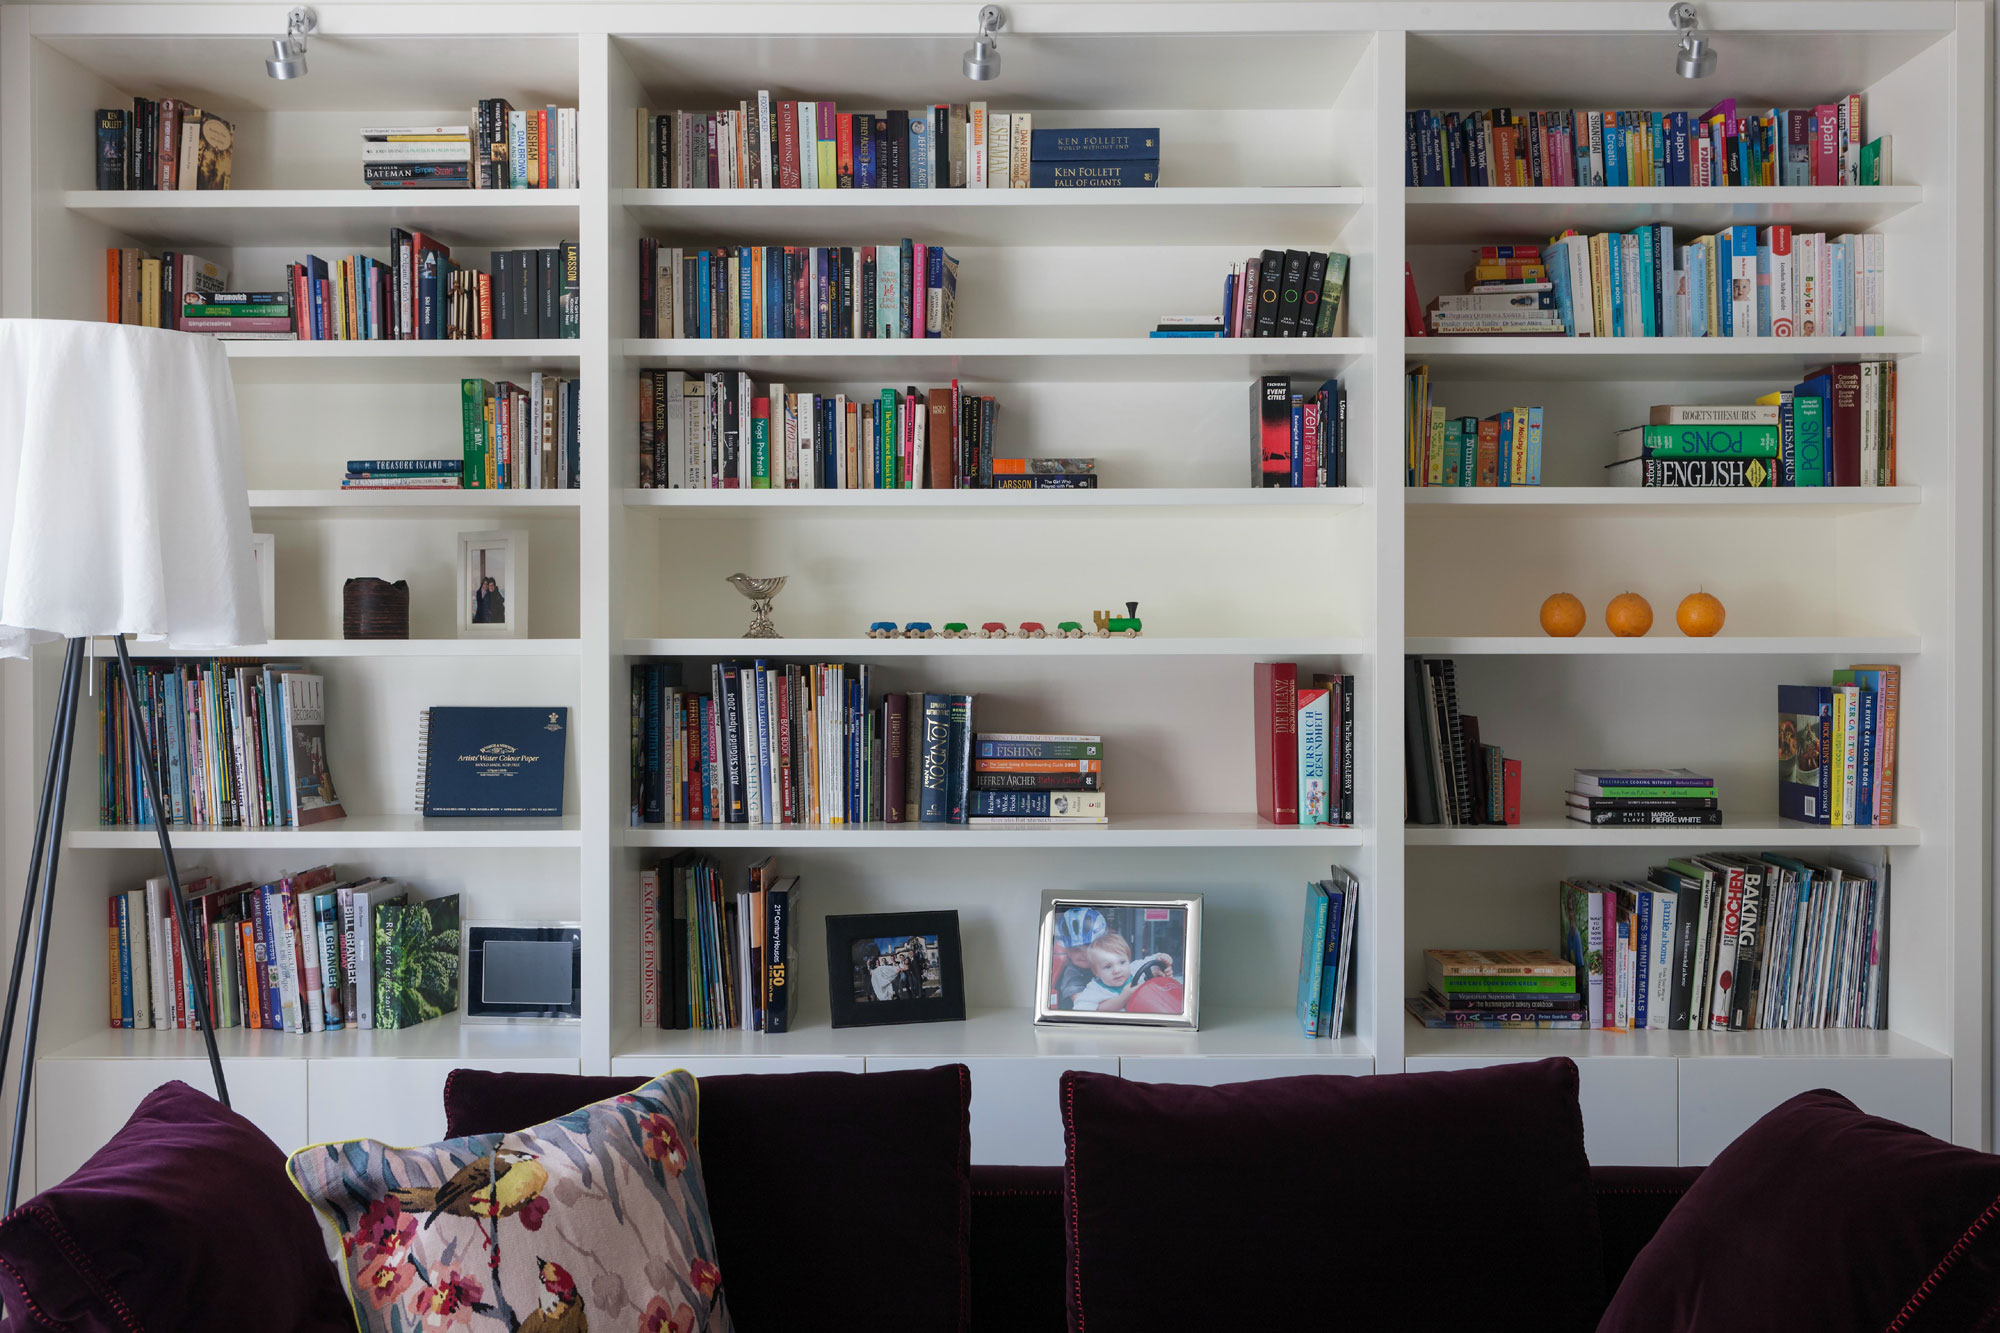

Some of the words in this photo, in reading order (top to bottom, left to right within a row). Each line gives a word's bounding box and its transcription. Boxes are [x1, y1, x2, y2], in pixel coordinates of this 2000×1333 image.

[102, 120, 122, 129] FOLLETT
[107, 112, 117, 120] KEN
[859, 116, 870, 137] JEFFREY
[974, 109, 983, 146] GERMANIA
[1794, 115, 1802, 142] Britain
[517, 130, 526, 146] DAN
[527, 120, 538, 161] GRISHAM
[785, 133, 793, 162] IRVING
[859, 137, 870, 156] ARCHER
[1020, 129, 1028, 145] DAN
[1057, 137, 1078, 146] KEN
[1084, 136, 1129, 145] FOLLETT
[1477, 131, 1486, 149] New
[1590, 115, 1601, 154] SHANGHAI
[1675, 131, 1686, 162] Japan
[1821, 117, 1837, 154] Spain
[517, 148, 526, 178] BROWN
[989, 126, 1008, 175] SHAMAN
[1020, 147, 1028, 176] BROWN
[1469, 140, 1477, 167] Munich
[1477, 149, 1486, 169] York
[1608, 134, 1617, 167] Croatia
[366, 169, 412, 178] BATEMAN
[1054, 168, 1075, 177] KEN
[1078, 167, 1122, 177] FOLLETT
[1054, 179, 1073, 187] FALL
[1075, 179, 1087, 187] OF
[1091, 178, 1122, 187] GIANTS
[401, 253, 410, 280] Origami
[567, 246, 577, 281] LARSSON
[401, 281, 410, 302] Artist's
[1248, 269, 1256, 294] OSCAR
[1804, 276, 1814, 298] Baby
[1246, 295, 1254, 319] WILDE
[1804, 299, 1813, 315] Talk
[656, 373, 666, 402] JEFFREY
[656, 403, 666, 431] ARCHER
[1305, 408, 1317, 435] zen
[1682, 410, 1711, 420] ROGET'S
[1713, 410, 1757, 420] THESAURUS
[756, 420, 765, 440] Yoga
[1517, 427, 1525, 450] Holiday
[1681, 431, 1743, 454] PONS
[756, 441, 765, 476] Pretzels
[1784, 411, 1795, 482] THESAURUS
[1801, 420, 1819, 471] PONS
[376, 461, 414, 470] TREASURE
[416, 461, 442, 470] ISLAND
[1465, 438, 1474, 487] Numbers
[1661, 460, 1745, 487] ENGLISH
[998, 480, 1032, 488] LARSSON
[758, 677, 766, 703] WHERE
[1275, 679, 1288, 713] BILANZ
[759, 704, 766, 714] TO
[1849, 692, 1857, 719] RIVER
[728, 712, 736, 732] Alpen
[759, 715, 766, 727] GO
[760, 728, 767, 736] IN
[1275, 717, 1288, 734] DIE
[1822, 722, 1830, 737] RICK
[730, 733, 739, 767] SkiGuide
[927, 717, 949, 791] LONDON
[997, 747, 1042, 757] FISHING
[1306, 711, 1314, 777] KURSBUCH
[1315, 711, 1323, 777] GESUNDHEIT
[1822, 739, 1830, 764] STEIN'S
[1847, 742, 1855, 762] TWO
[521, 755, 540, 763] Paper
[666, 752, 672, 764] ON
[731, 767, 740, 785] ADAC
[747, 755, 758, 811] FISHING
[977, 774, 1005, 786] JEFFREY
[1006, 774, 1036, 786] ARCHER
[644, 882, 653, 947] EXCHANGE
[1641, 895, 1649, 931] JAMIE'S
[1662, 899, 1674, 931] jamie
[1724, 869, 1744, 936] KOCHEN
[1739, 873, 1761, 946] BAKING
[255, 917, 263, 941] OLIVER
[345, 906, 354, 930] BILL
[773, 916, 781, 939] Century
[339, 934, 347, 969] HOLIDAY
[385, 922, 393, 965] Riverford
[1639, 932, 1648, 979] 30-MINUTE
[1660, 939, 1669, 965] home
[326, 936, 337, 989] GRANGER
[346, 931, 357, 984] GRANGER
[645, 950, 654, 1005] FINDINGS
[773, 962, 785, 986] 150
[1638, 980, 1646, 1011] MEALS
[1455, 1013, 1535, 1021] SALADS
